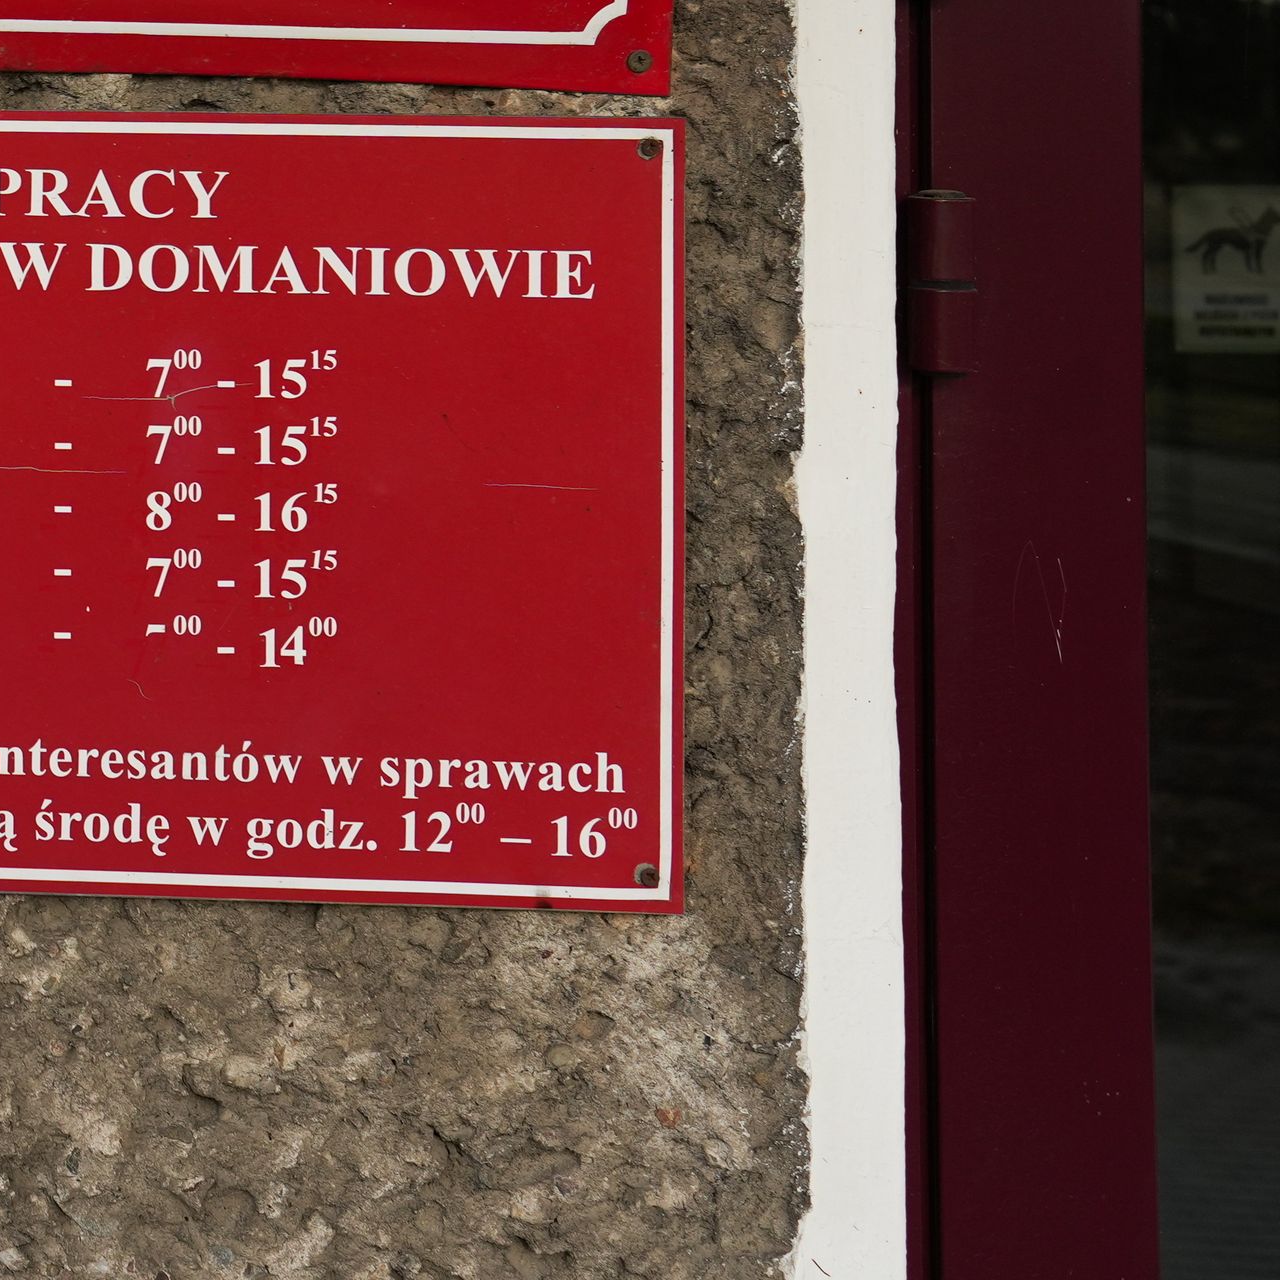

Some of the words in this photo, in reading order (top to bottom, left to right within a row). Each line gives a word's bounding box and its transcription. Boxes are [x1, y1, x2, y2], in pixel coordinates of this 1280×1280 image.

[85, 243, 595, 300] DOMANIOWIE
[320, 756, 363, 786] w
[380, 751, 626, 800] sprawach
[35, 798, 170, 857] środę
[186, 816, 229, 846] w
[246, 808, 378, 860] godz.
